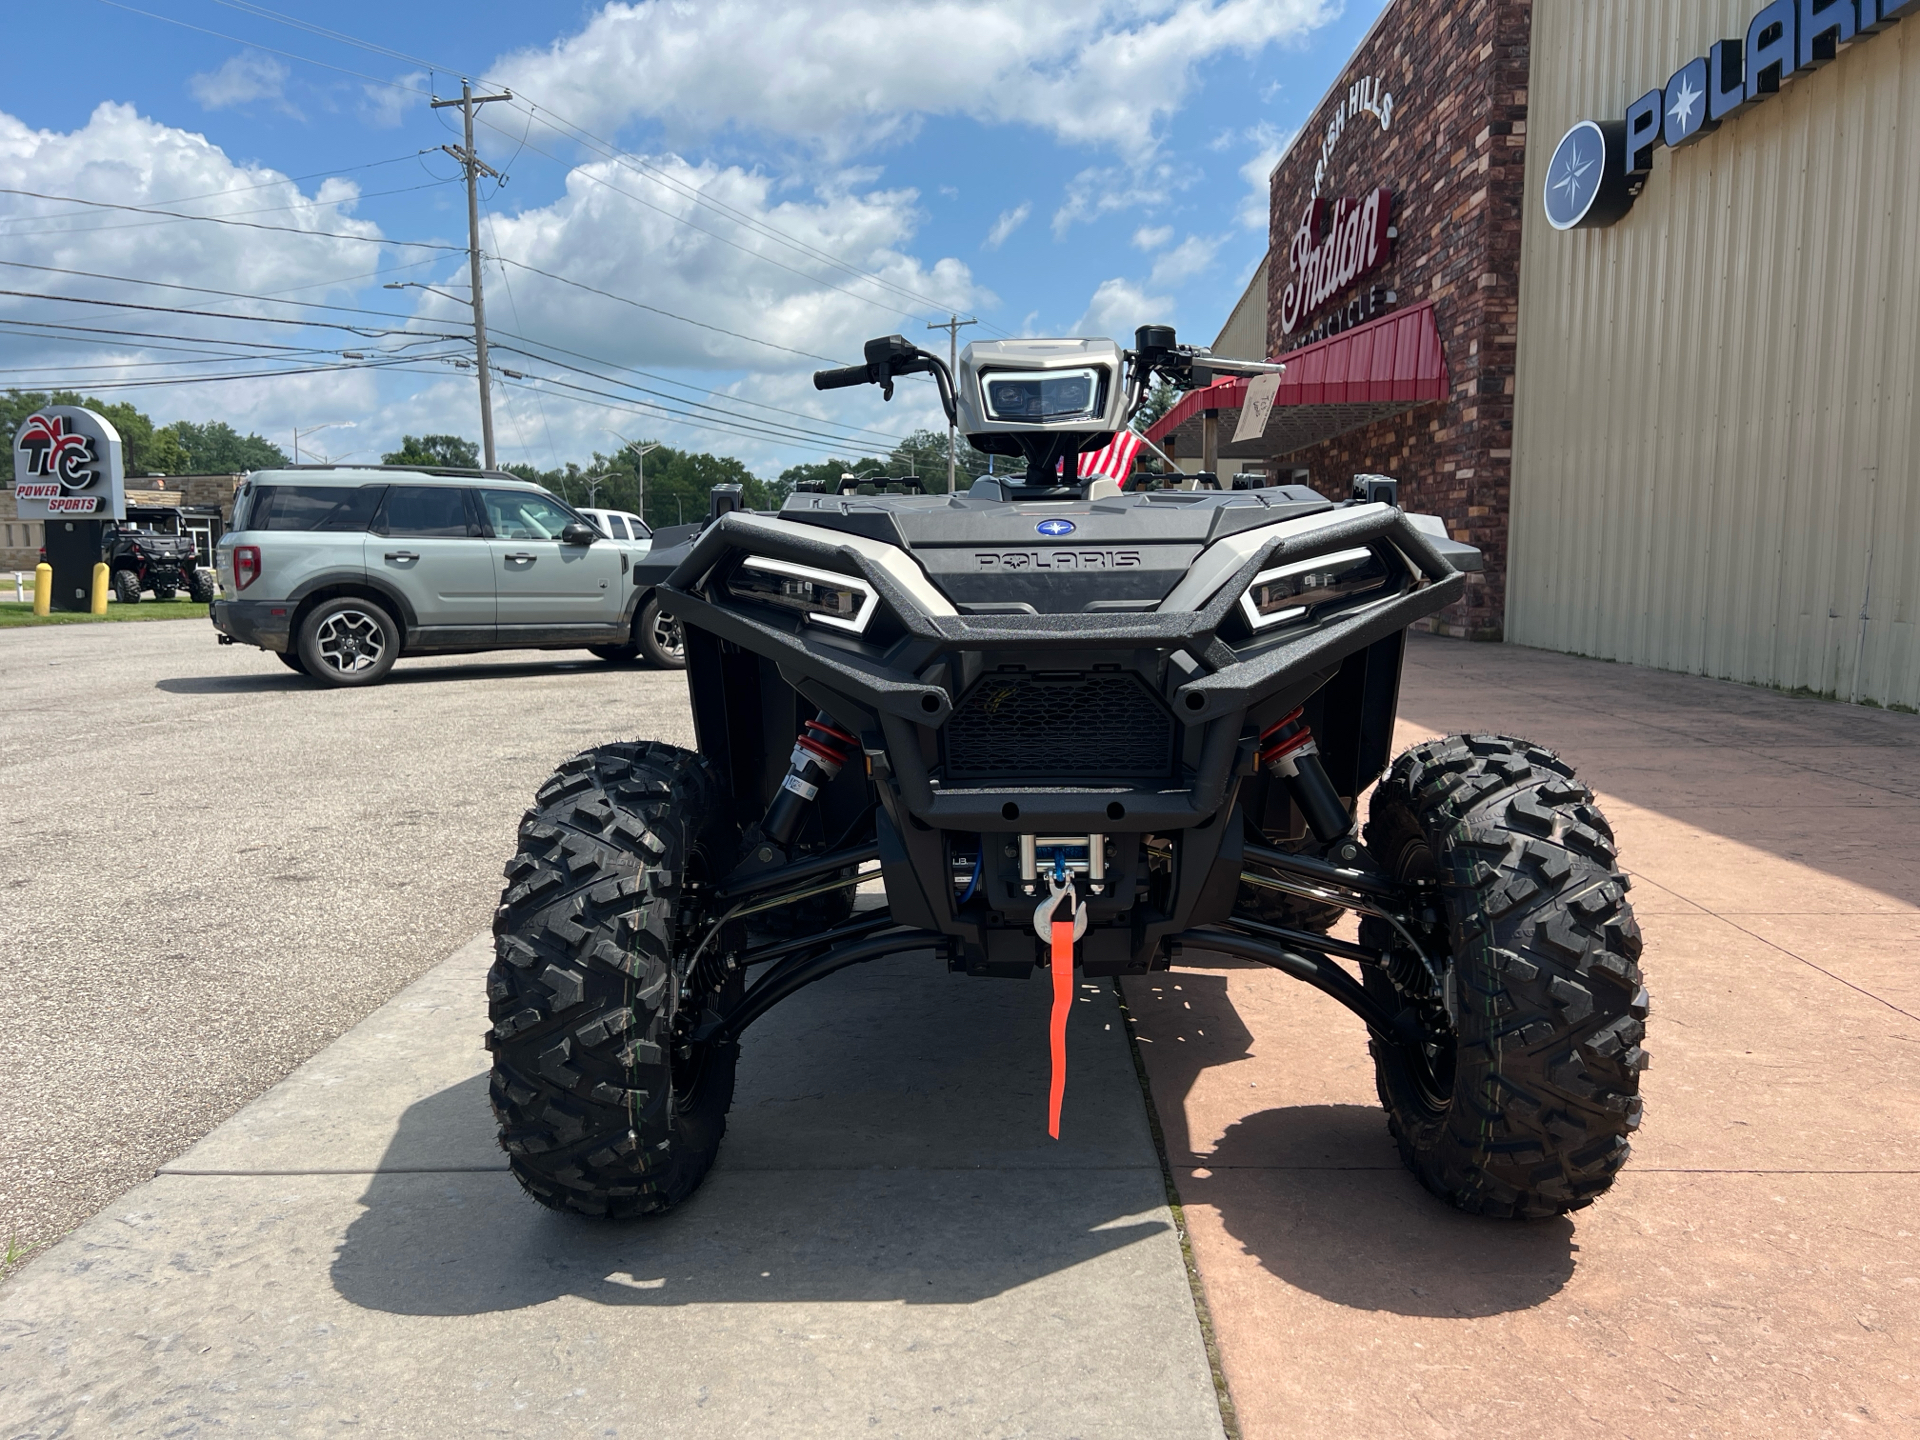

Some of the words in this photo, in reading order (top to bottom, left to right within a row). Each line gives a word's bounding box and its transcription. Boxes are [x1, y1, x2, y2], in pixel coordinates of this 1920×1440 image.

[1348, 75, 1394, 131] HILLS
[1282, 187, 1382, 335] Indian
[1285, 285, 1376, 354] TORCYCLE
[16, 485, 59, 496] POWER
[49, 499, 95, 510] SPORTS
[974, 551, 1141, 571] POLARIS
